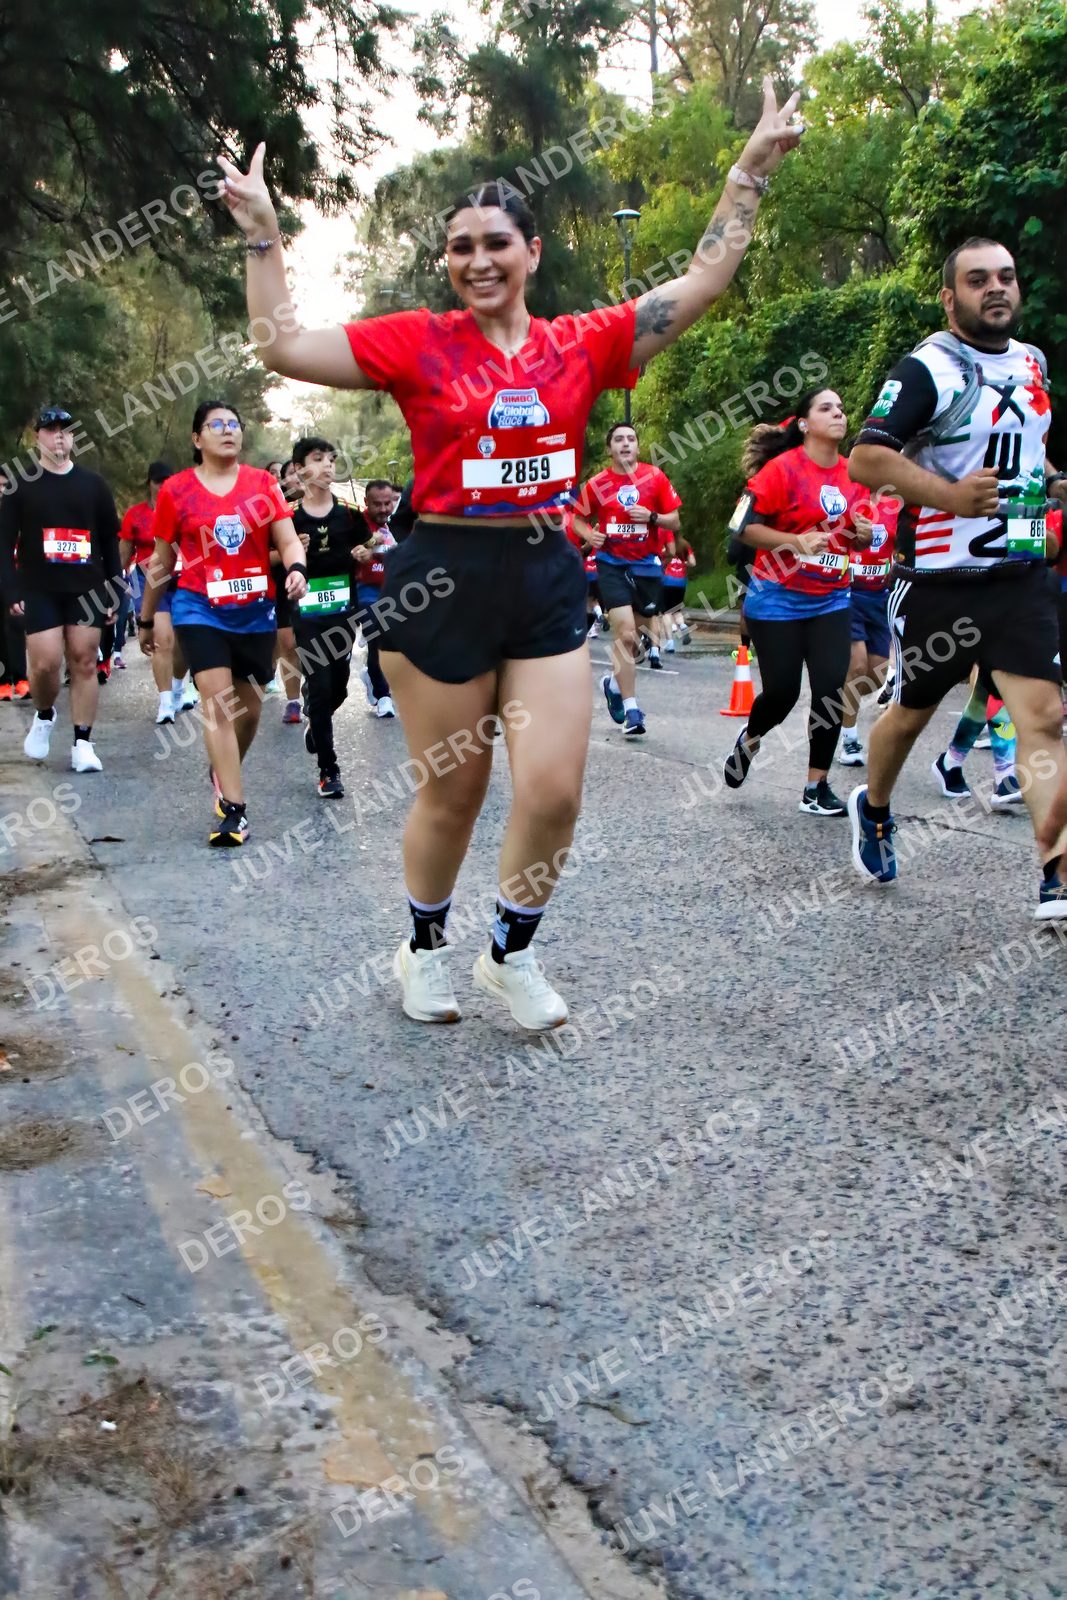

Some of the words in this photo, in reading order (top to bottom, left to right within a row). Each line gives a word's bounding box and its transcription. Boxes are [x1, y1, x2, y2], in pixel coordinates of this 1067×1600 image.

[501, 395, 533, 403] BIMBO
[504, 405, 535, 417] Global
[497, 415, 523, 426] Race
[501, 456, 551, 484] 2859
[617, 524, 636, 533] 2325
[56, 541, 77, 552] 3273
[819, 554, 839, 567] 3121
[861, 565, 881, 575] 3387
[228, 578, 253, 594] 1896
[317, 590, 336, 603] 865
